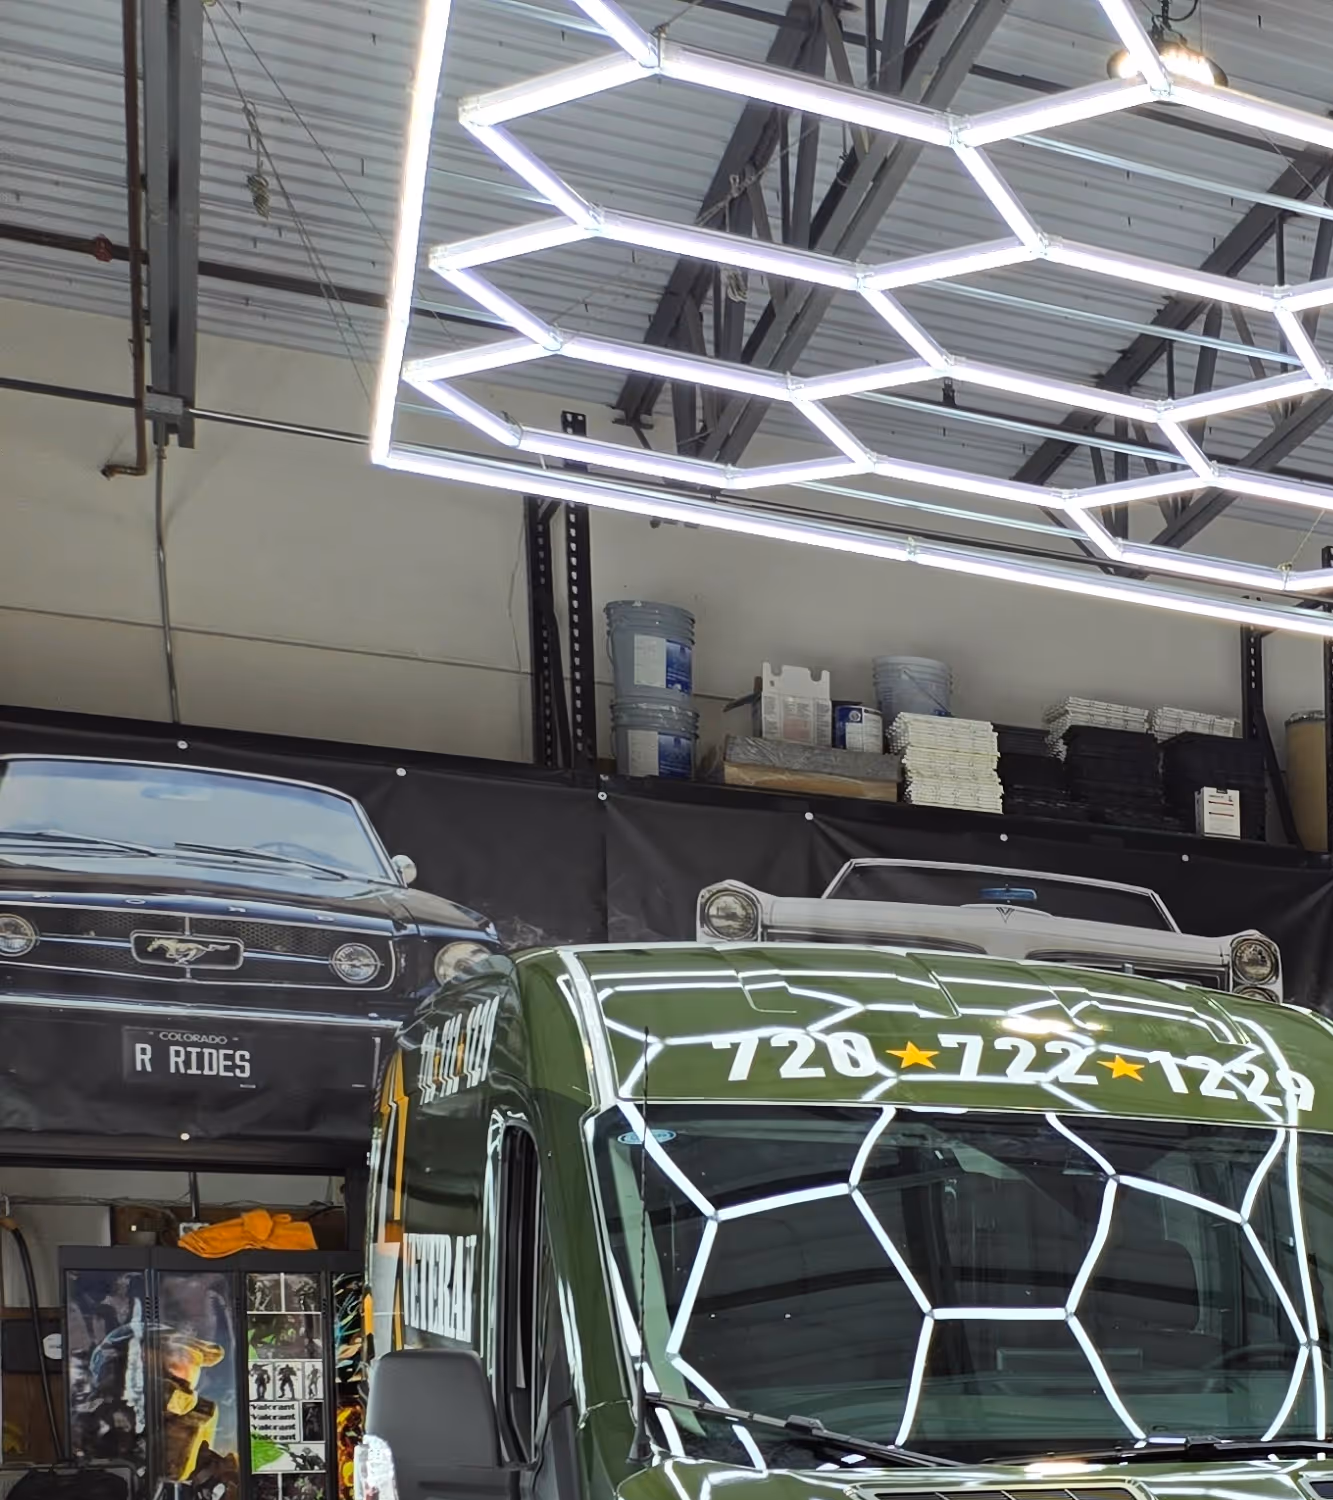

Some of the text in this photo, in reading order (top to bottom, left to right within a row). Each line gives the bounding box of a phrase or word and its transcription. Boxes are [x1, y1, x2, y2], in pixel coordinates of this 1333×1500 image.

[159, 1032, 228, 1044] COLORADO
[135, 1043, 251, 1078] R RIDES
[711, 1031, 878, 1081] 720
[937, 1033, 1100, 1085] 722
